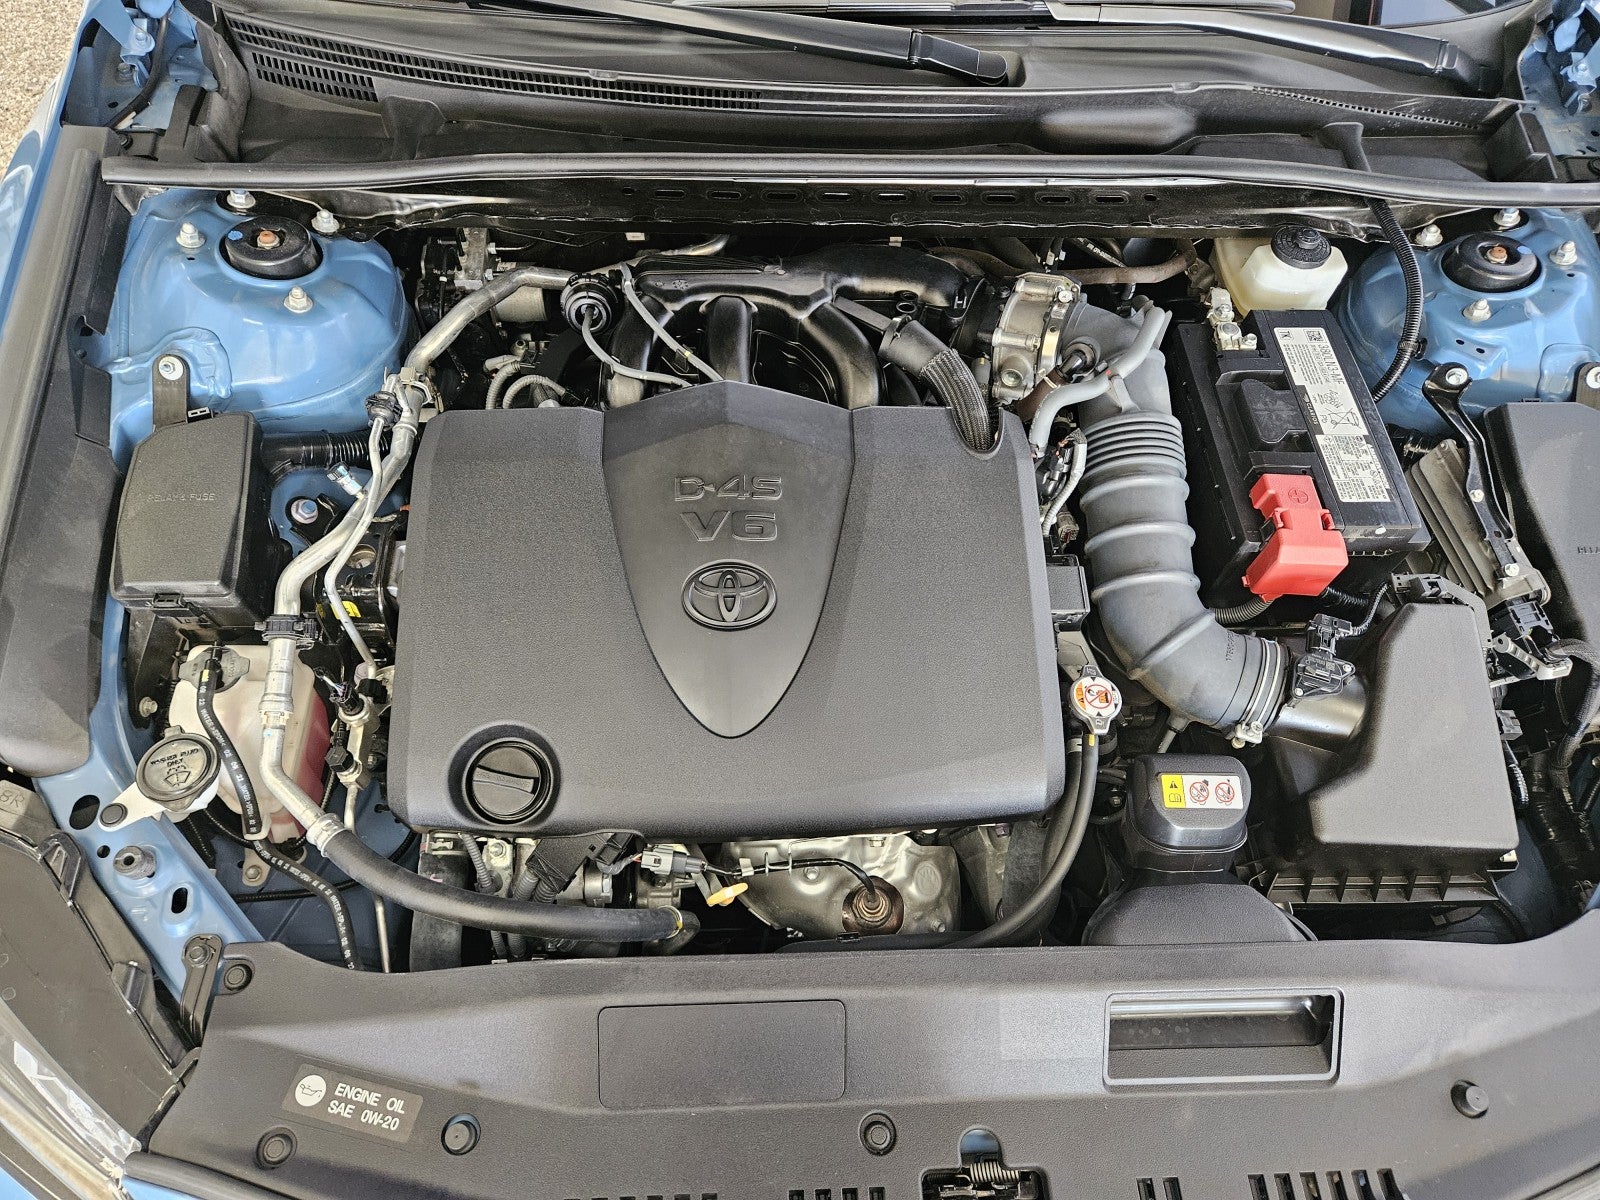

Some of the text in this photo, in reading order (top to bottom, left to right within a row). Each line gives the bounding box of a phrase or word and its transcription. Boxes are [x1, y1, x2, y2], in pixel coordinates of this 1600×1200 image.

[1306, 402, 1319, 425] CLARIOS
[680, 510, 778, 542] V6
[334, 1082, 406, 1115] ENGINE OIL
[327, 1099, 400, 1131] SAE 0W-20
